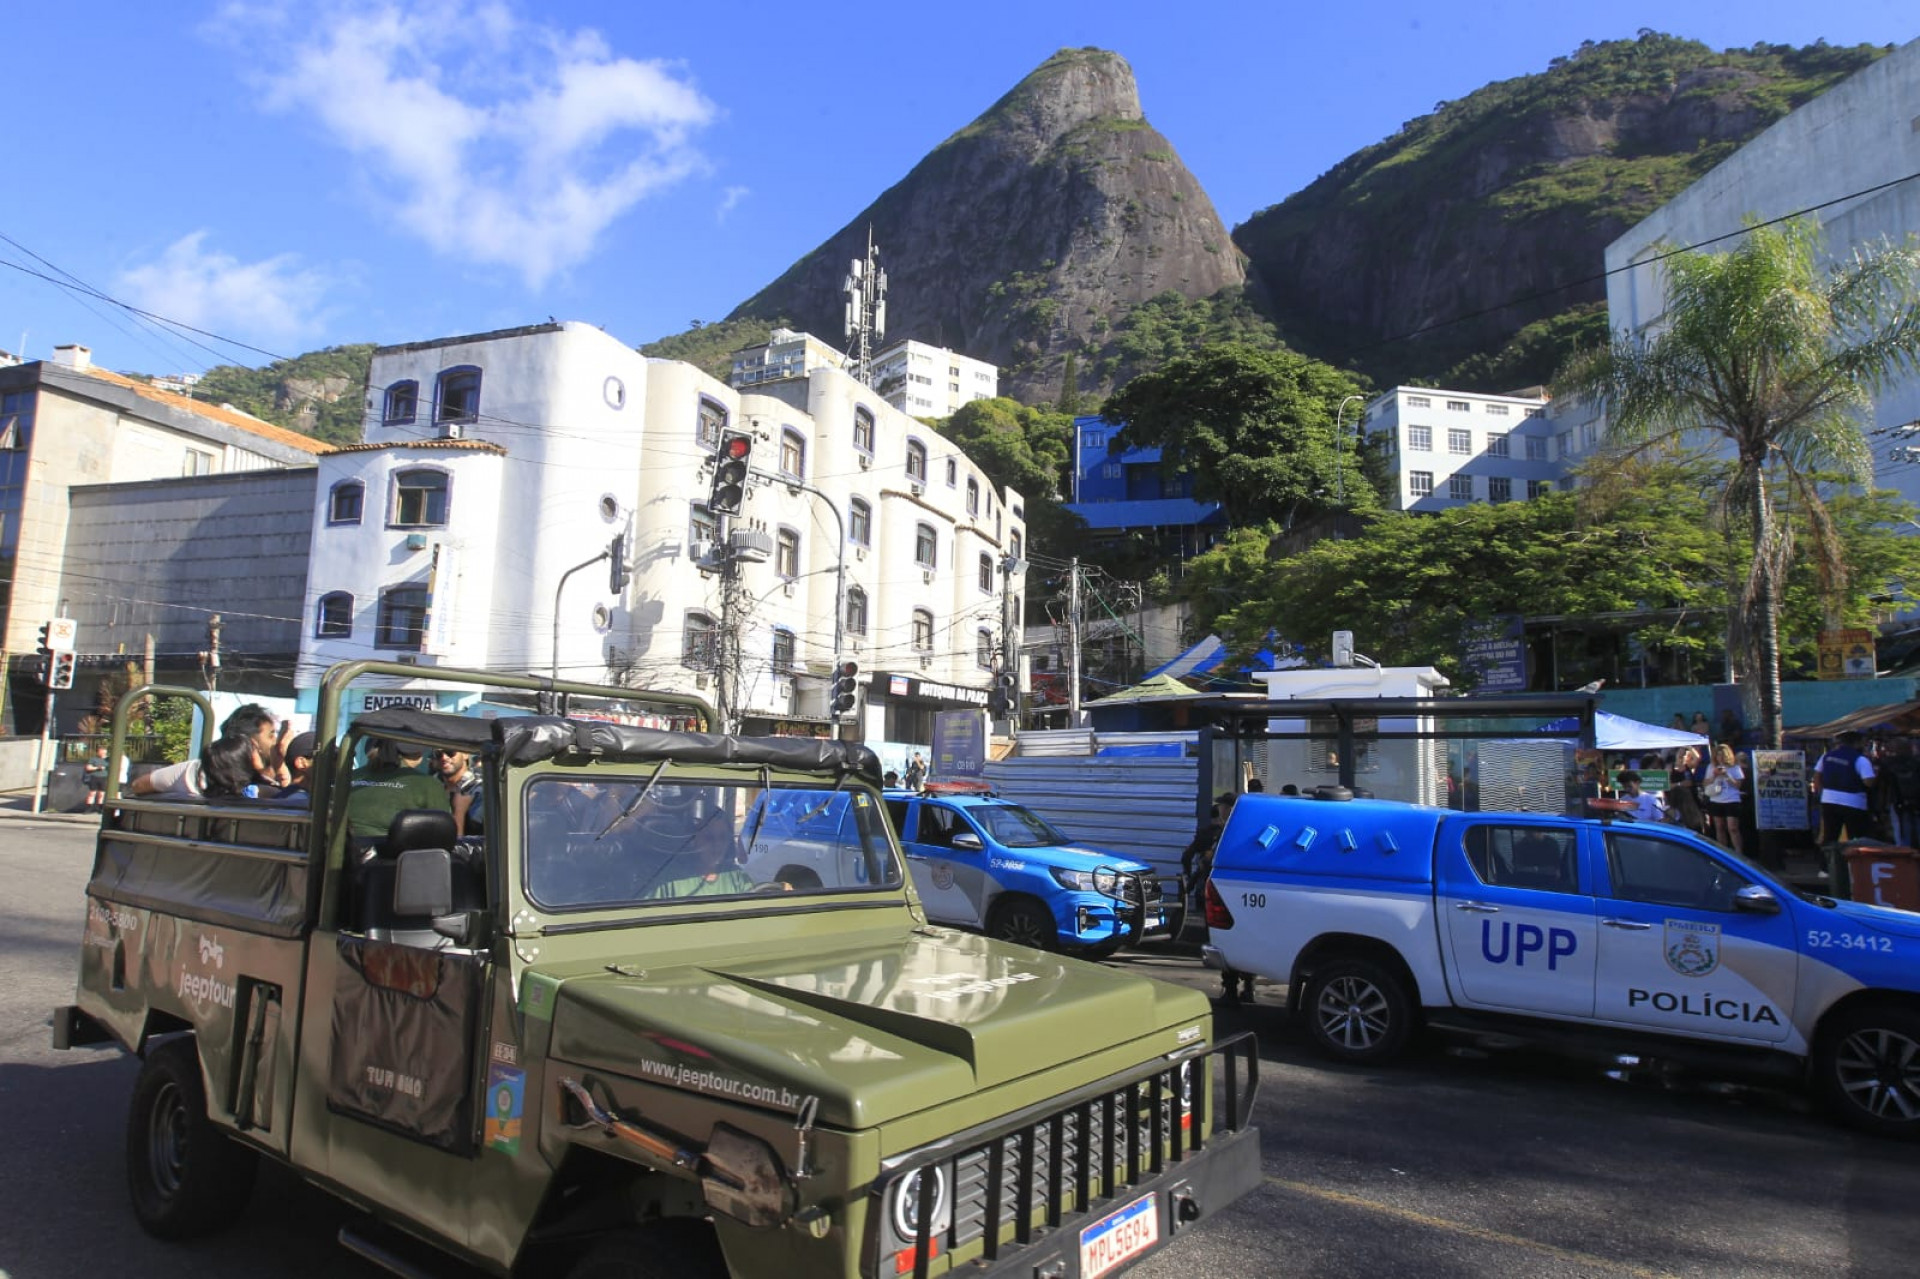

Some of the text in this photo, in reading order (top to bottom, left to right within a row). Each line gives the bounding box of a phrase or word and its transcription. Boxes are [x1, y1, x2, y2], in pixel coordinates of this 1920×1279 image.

[364, 695, 433, 711] ENTRADA
[754, 844, 769, 854] 190
[1241, 893, 1266, 908] 190
[1481, 919, 1578, 972] UPP
[1807, 930, 1894, 953] 52-3412
[177, 963, 236, 1009] jeeptour
[1628, 987, 1780, 1027] POLÍCIA
[641, 1057, 800, 1109] www.jeeptour.com.br
[1089, 1213, 1149, 1274] MPL5G94
